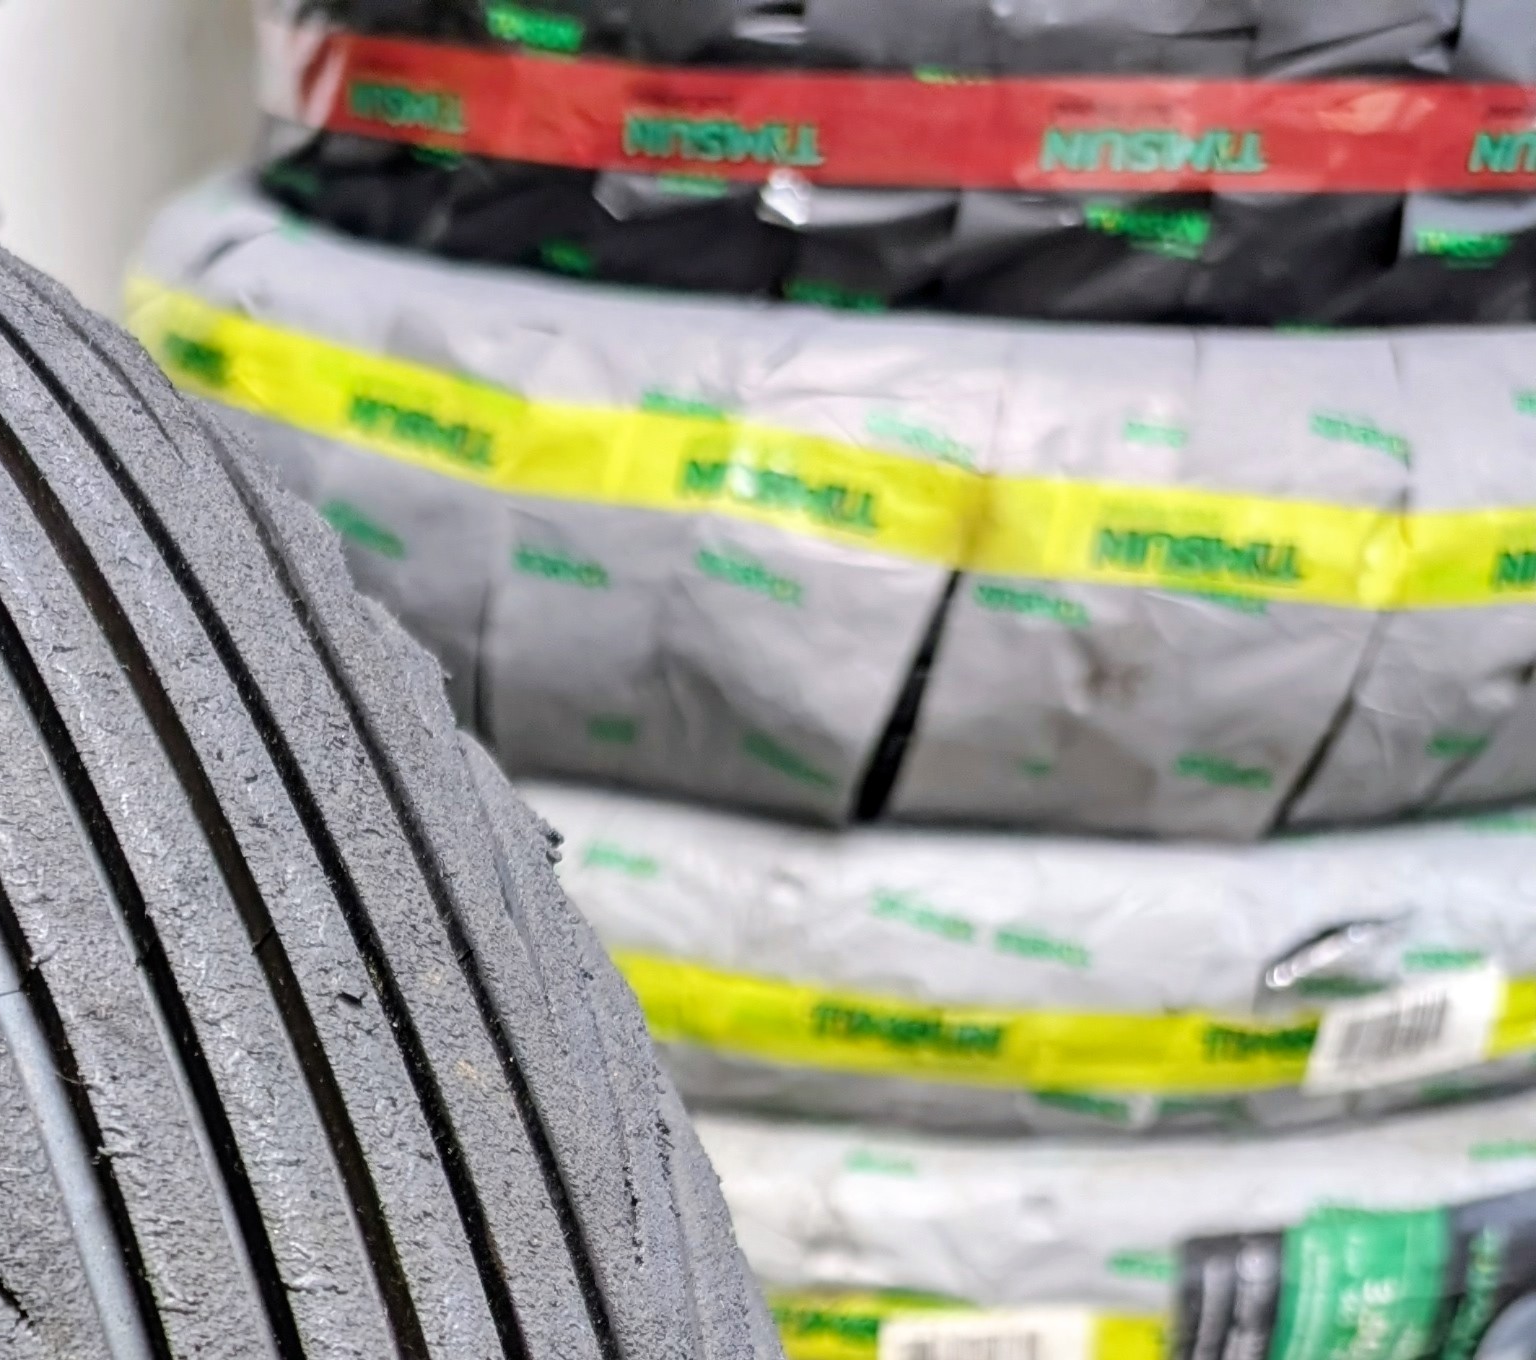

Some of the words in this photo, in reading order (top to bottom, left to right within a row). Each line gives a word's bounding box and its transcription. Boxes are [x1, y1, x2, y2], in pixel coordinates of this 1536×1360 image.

[624, 112, 824, 166] TIMSUN
[1039, 128, 1268, 174] TIMSUN
[1094, 529, 1302, 584] TIMSUN
